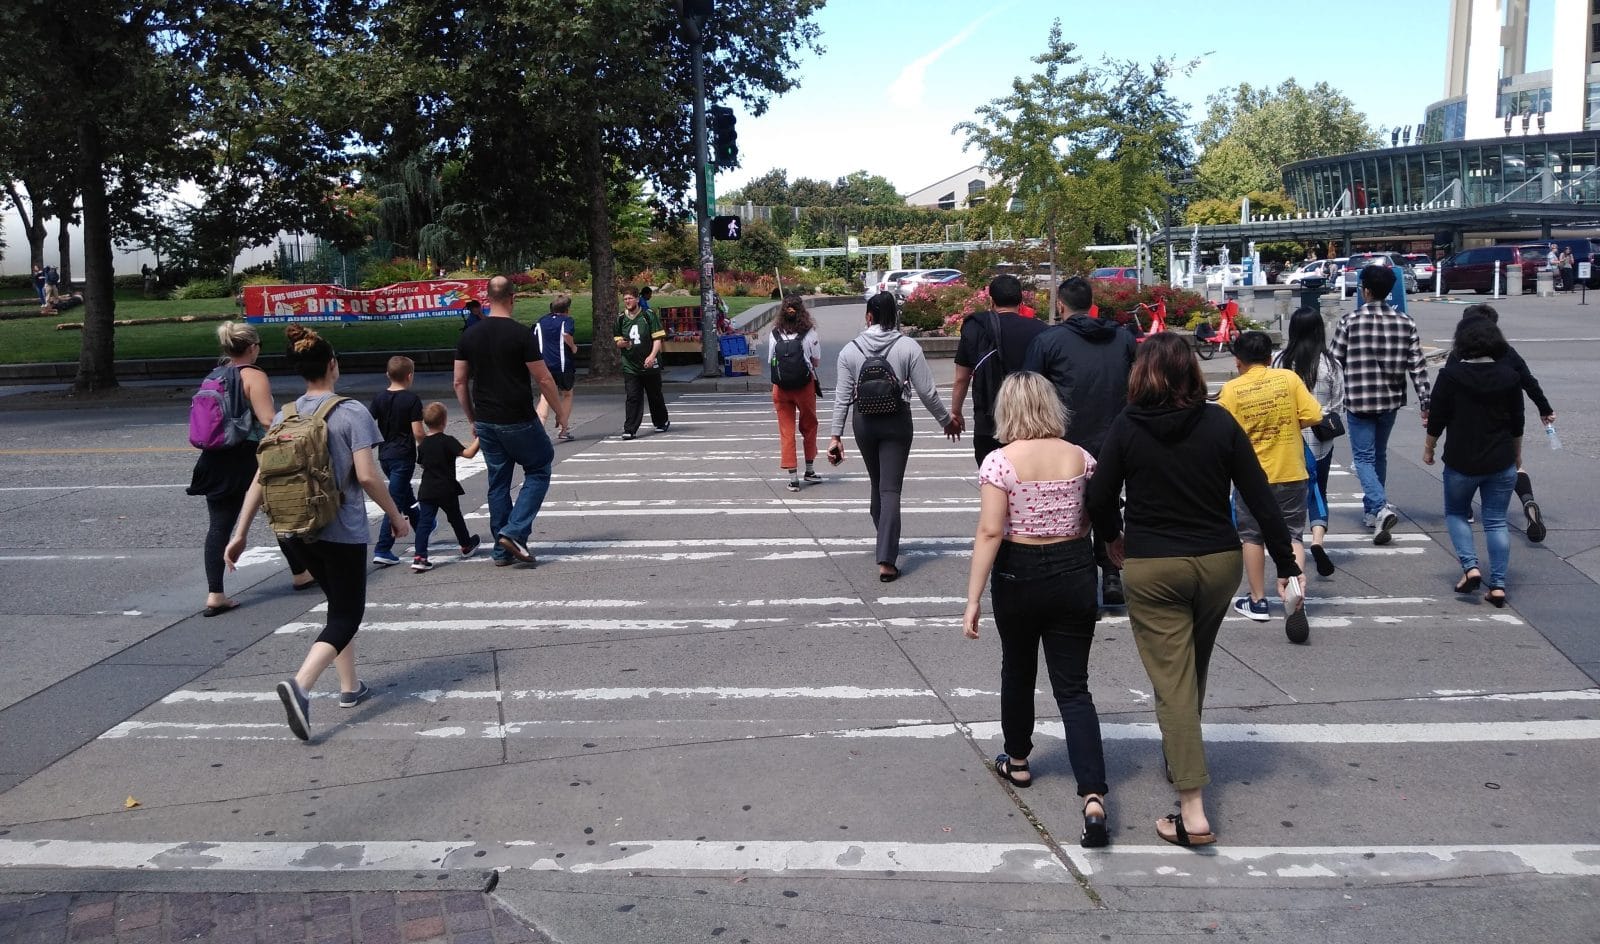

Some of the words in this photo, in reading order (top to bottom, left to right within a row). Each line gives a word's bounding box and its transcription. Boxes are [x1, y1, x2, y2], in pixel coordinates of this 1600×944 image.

[1356, 204, 1409, 215] SEATTLE
[1413, 200, 1455, 211] CENTER
[1251, 213, 1291, 222] SPACE
[382, 286, 419, 296] Appliance
[270, 293, 286, 302] THIS
[306, 298, 345, 313] BITE
[350, 299, 370, 313] OF
[375, 294, 442, 313] SEATTLE
[629, 324, 641, 345] 4
